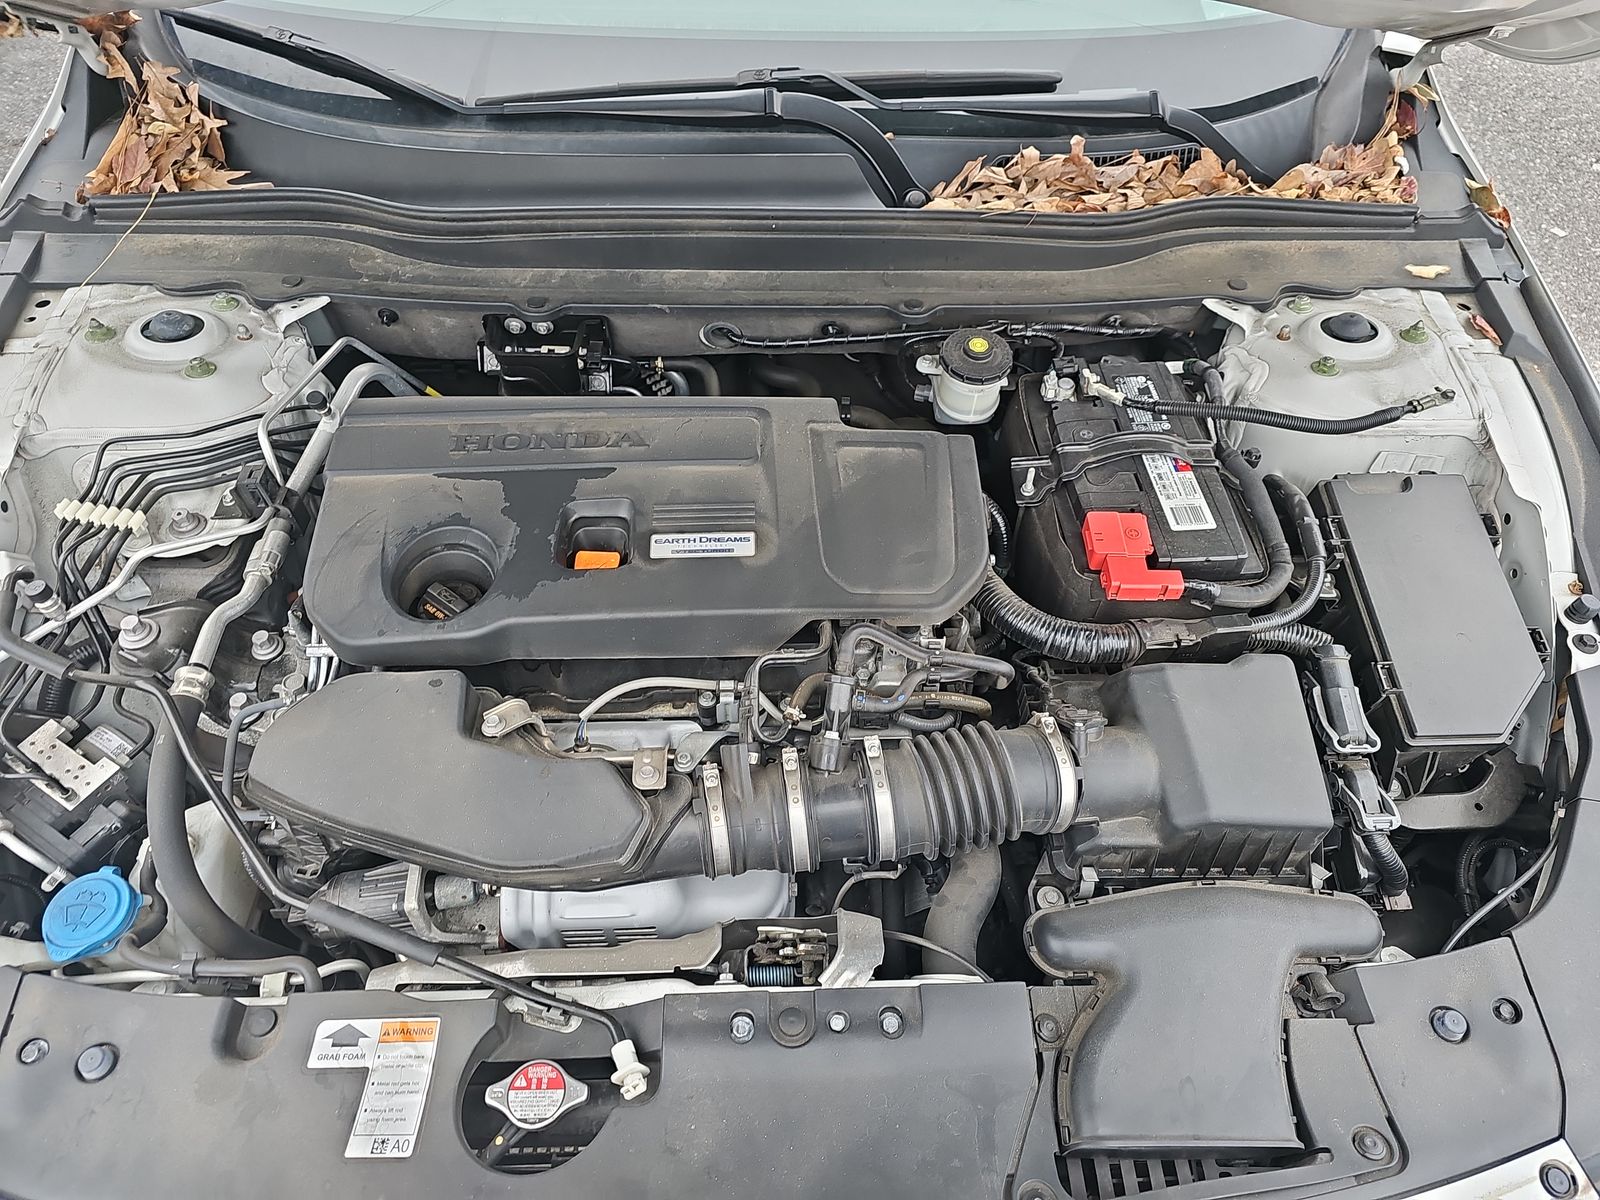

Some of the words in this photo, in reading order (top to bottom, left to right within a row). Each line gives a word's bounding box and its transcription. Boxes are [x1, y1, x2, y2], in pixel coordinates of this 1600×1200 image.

[449, 431, 650, 453] HONDA
[654, 537, 697, 545] EARTH
[424, 603, 436, 614] SAE
[392, 1027, 434, 1036] WARNING
[317, 1053, 340, 1061] GRAB
[390, 1138, 410, 1153] A0
